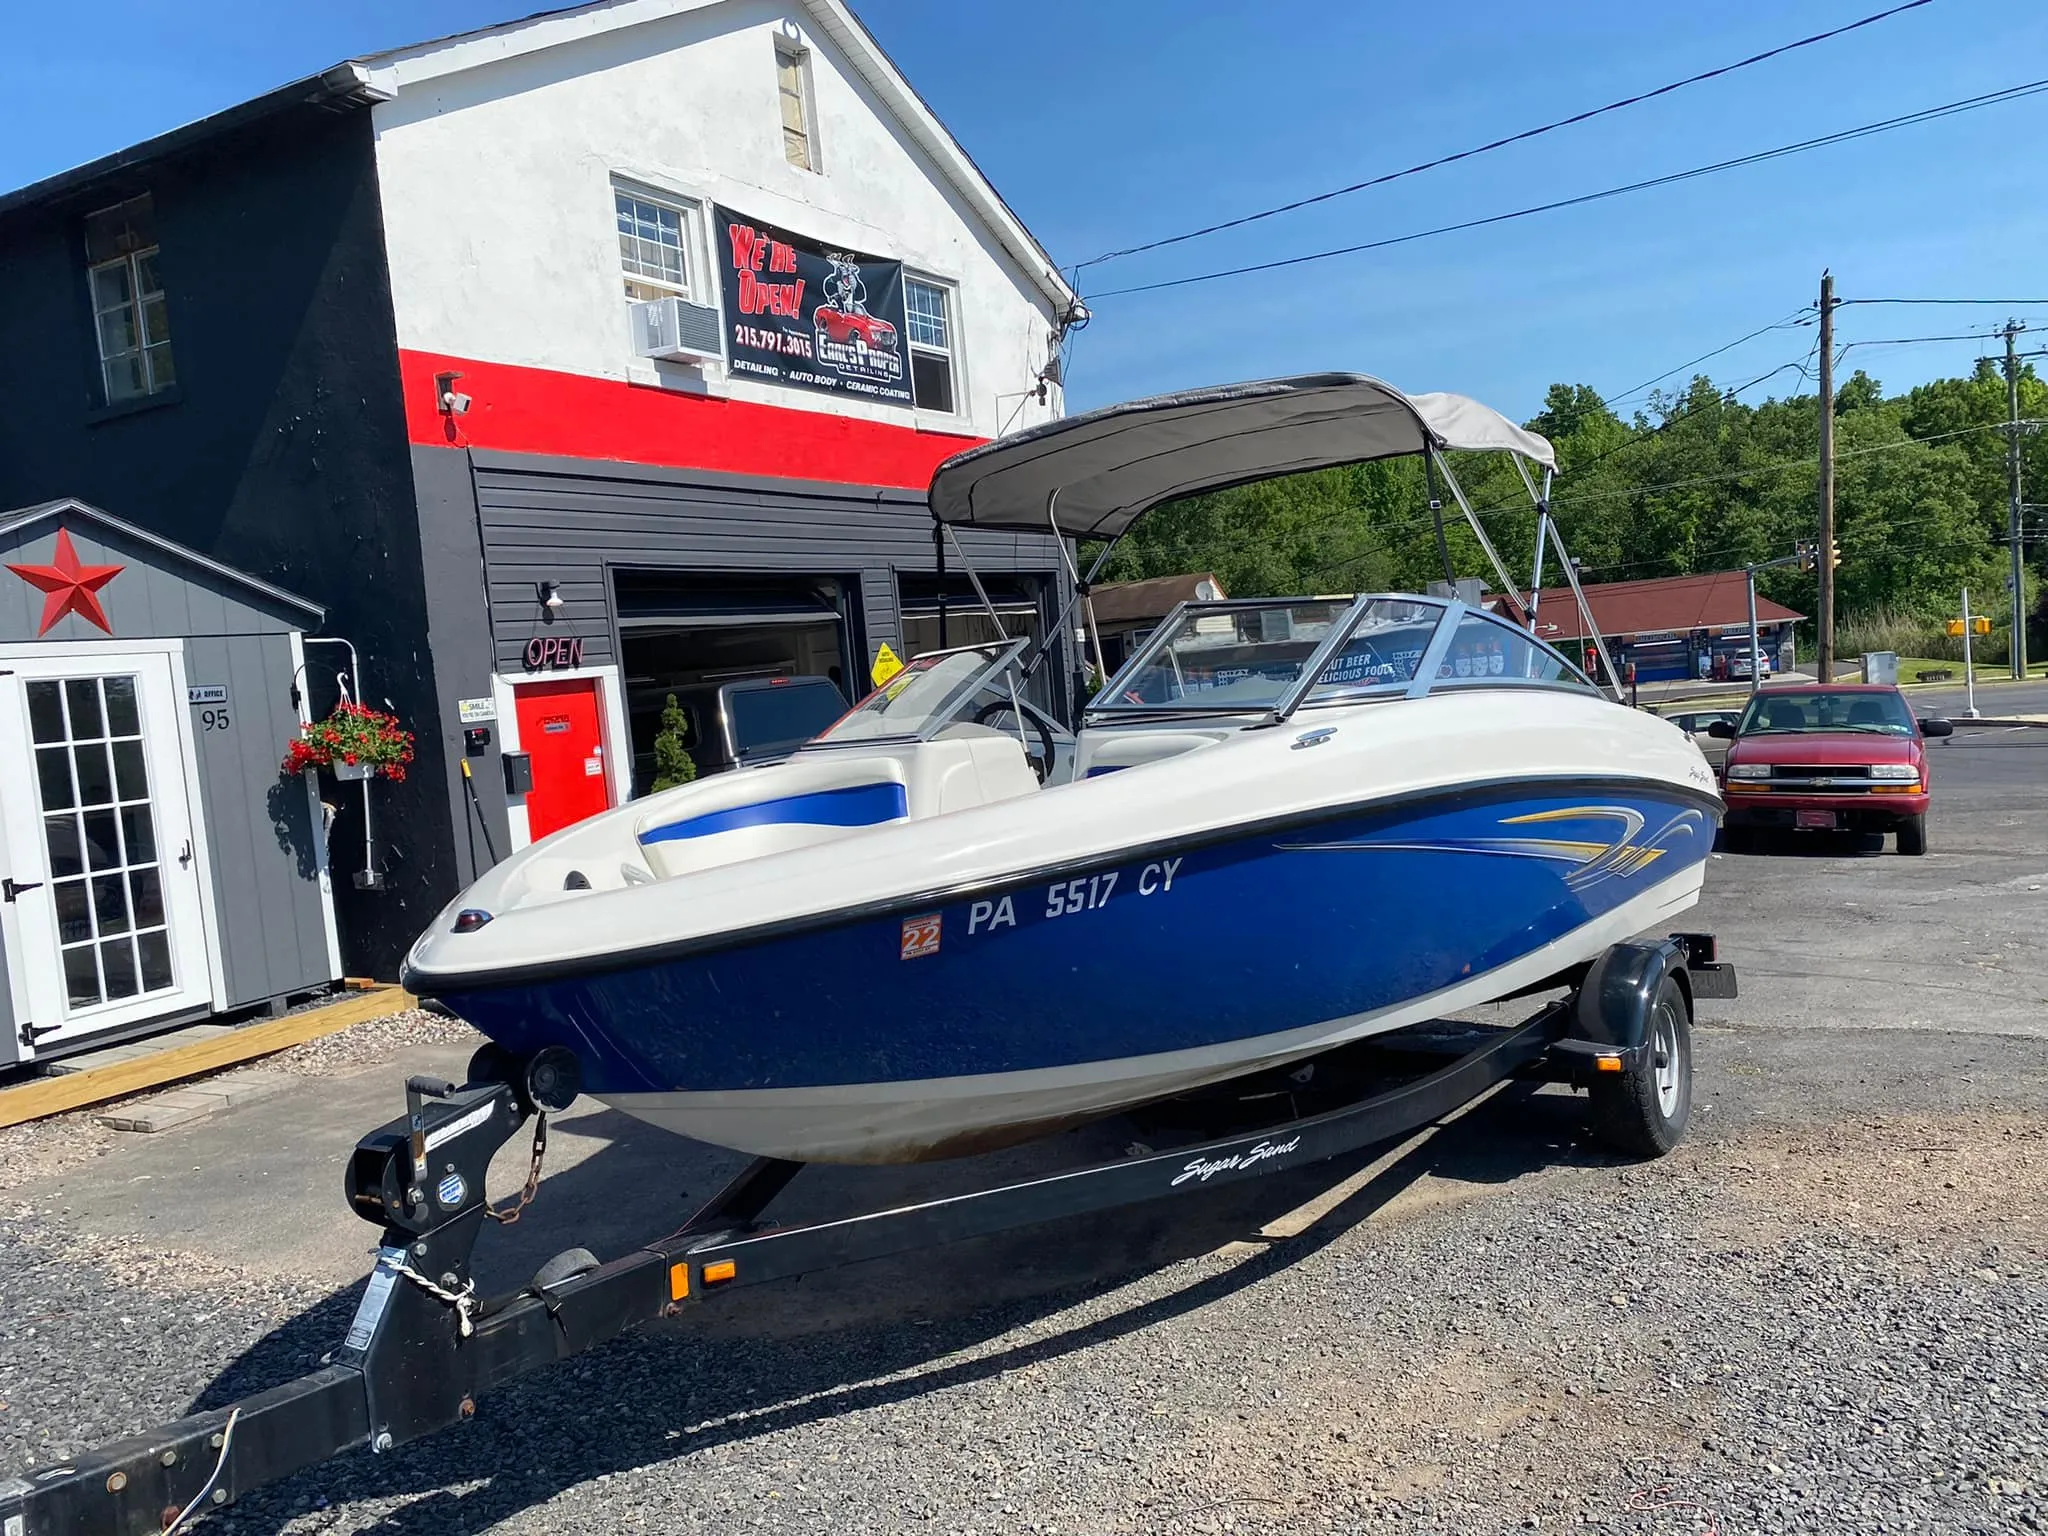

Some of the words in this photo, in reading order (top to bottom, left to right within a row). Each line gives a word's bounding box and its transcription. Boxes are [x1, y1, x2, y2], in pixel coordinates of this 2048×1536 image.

[729, 224, 797, 273] WE'RE
[738, 268, 806, 320] OPEN!
[735, 324, 812, 359] 215.791.3015
[733, 359, 779, 377] DETAILING
[789, 370, 813, 384] AUTO
[813, 374, 838, 388] BODY
[846, 381, 880, 395] CERAMIC
[879, 386, 911, 400] COATING
[527, 638, 584, 666] OPEN
[1346, 654, 1371, 667] BEER
[1318, 668, 1362, 683] ELICIOUS
[202, 709, 230, 732] 95
[967, 895, 1017, 935] PA
[1045, 872, 1119, 919] 5517
[1138, 857, 1183, 896] CY
[903, 925, 939, 951] 22
[1171, 1153, 1242, 1186] Sugar
[1238, 1135, 1301, 1170] Sand
